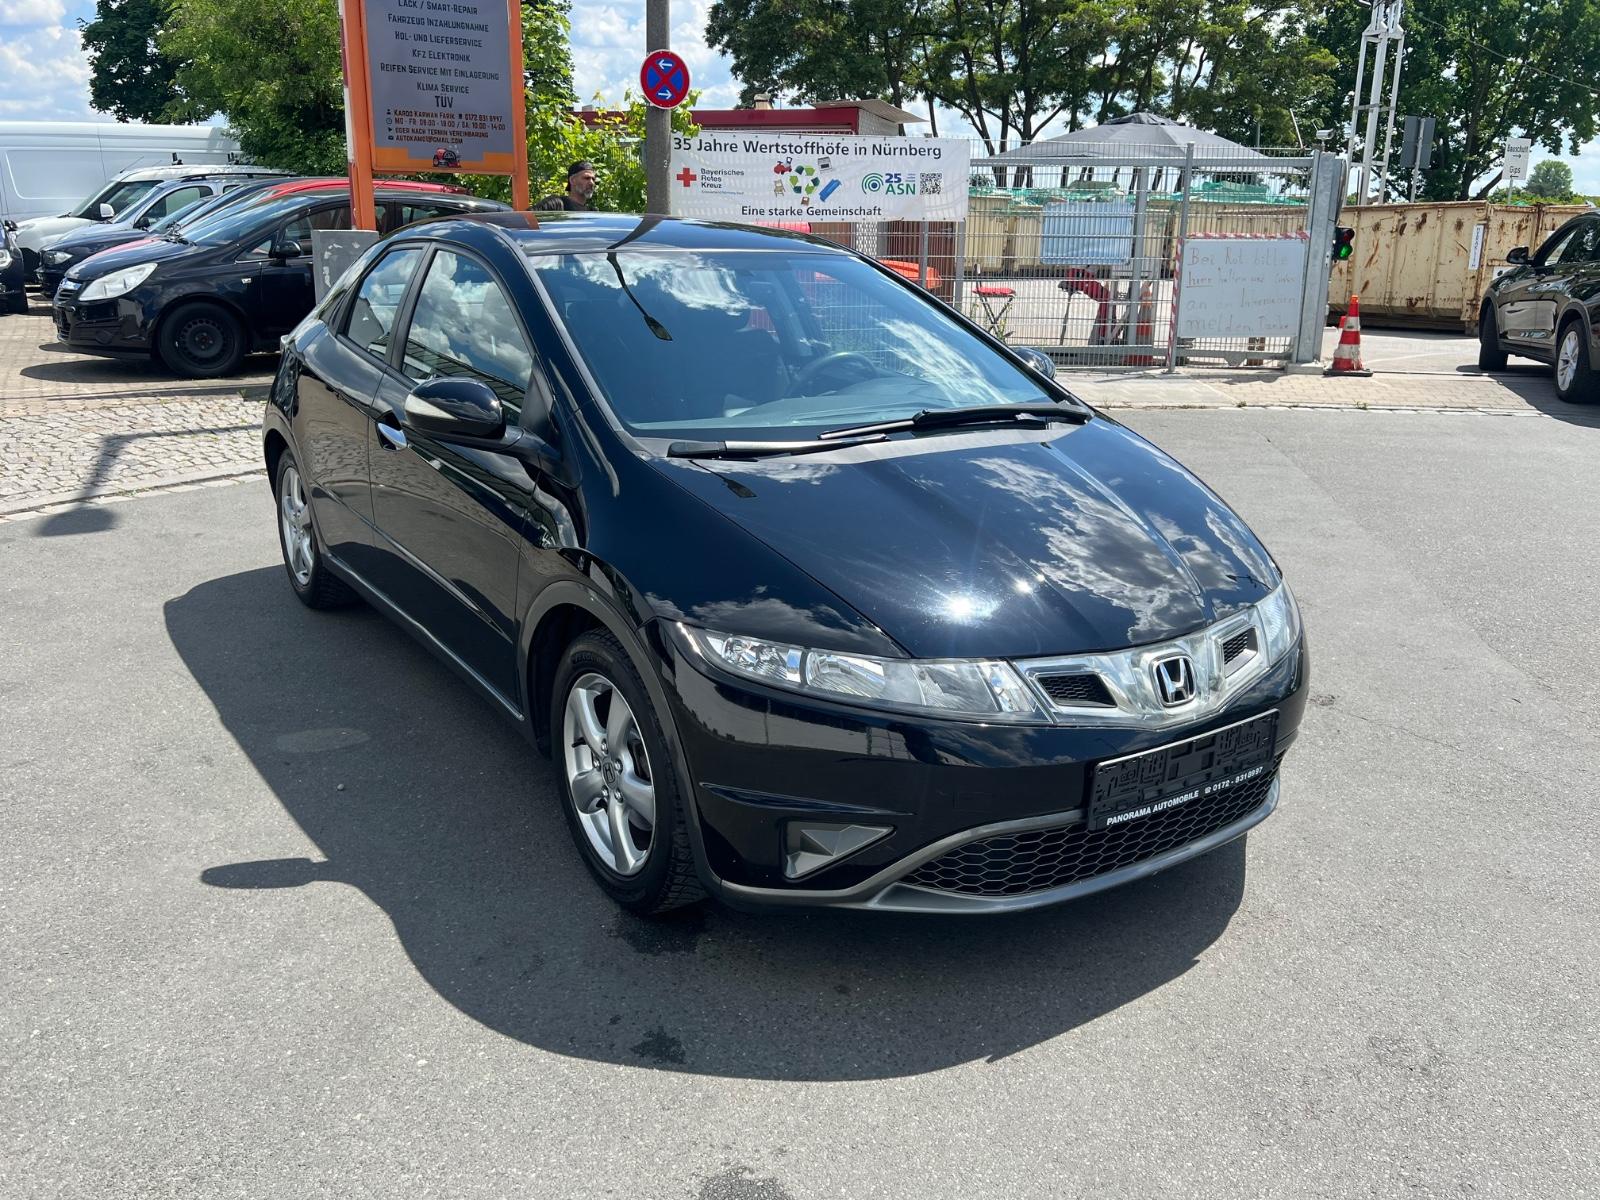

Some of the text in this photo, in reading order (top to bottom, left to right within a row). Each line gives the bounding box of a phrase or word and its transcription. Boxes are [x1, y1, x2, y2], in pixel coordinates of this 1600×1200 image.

[388, 13, 489, 32] FAHRZEUG INZAHLUNGNAHME
[395, 31, 482, 48] HOL- UND LIEFERSERVICE
[412, 49, 470, 62] KFZ ELEKTRONIK
[380, 63, 499, 81] REIFEN SERVICE MIT EINLAGERUNG
[417, 83, 469, 93] KLIMA SERVICE
[435, 93, 454, 108] TÜV
[674, 138, 941, 159] 35 Jahre Wertstoffhöfe in Nürnberg
[701, 168, 744, 176] Bayerisches
[885, 173, 901, 183] 25
[885, 183, 916, 195] ASN
[741, 206, 882, 216] Eine starke Gemeinschaft
[1106, 807, 1151, 825] PANORAMA
[1152, 790, 1199, 813] AUTOMOBILE
[1212, 780, 1230, 791] 0172
